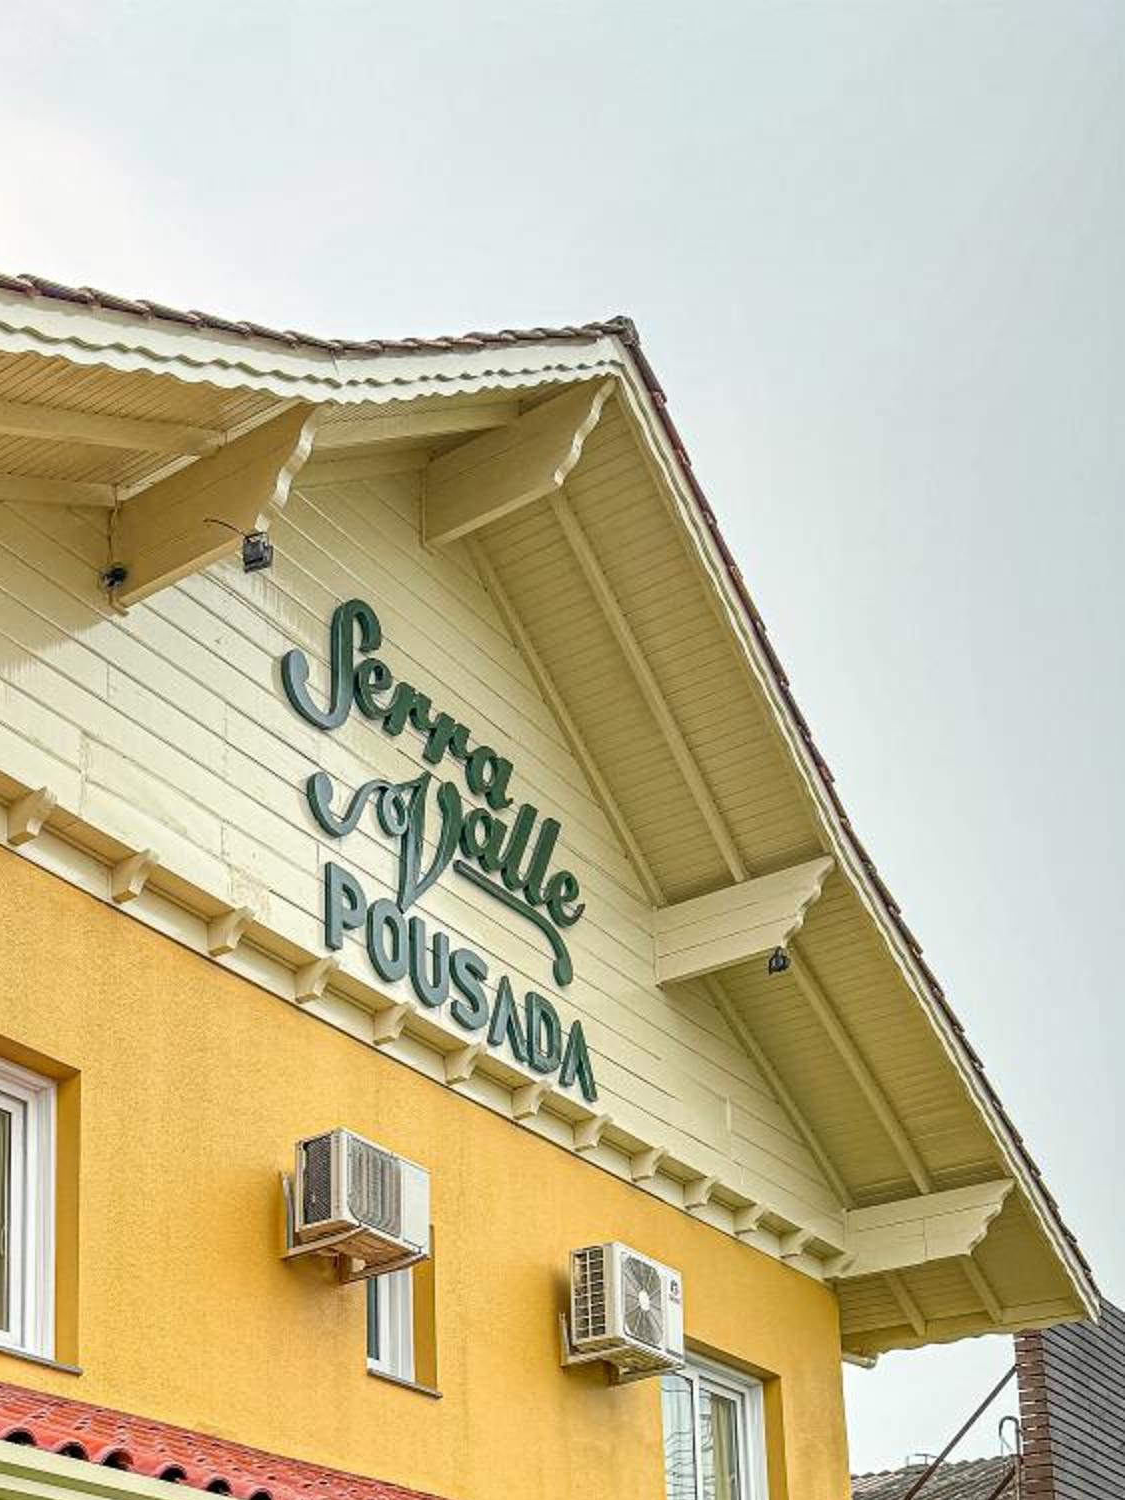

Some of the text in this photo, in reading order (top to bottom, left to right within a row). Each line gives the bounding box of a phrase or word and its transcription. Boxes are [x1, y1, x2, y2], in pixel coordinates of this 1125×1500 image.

[281, 598, 515, 809] Serra
[307, 770, 587, 930] Valle
[324, 861, 599, 1103] POUSADA
